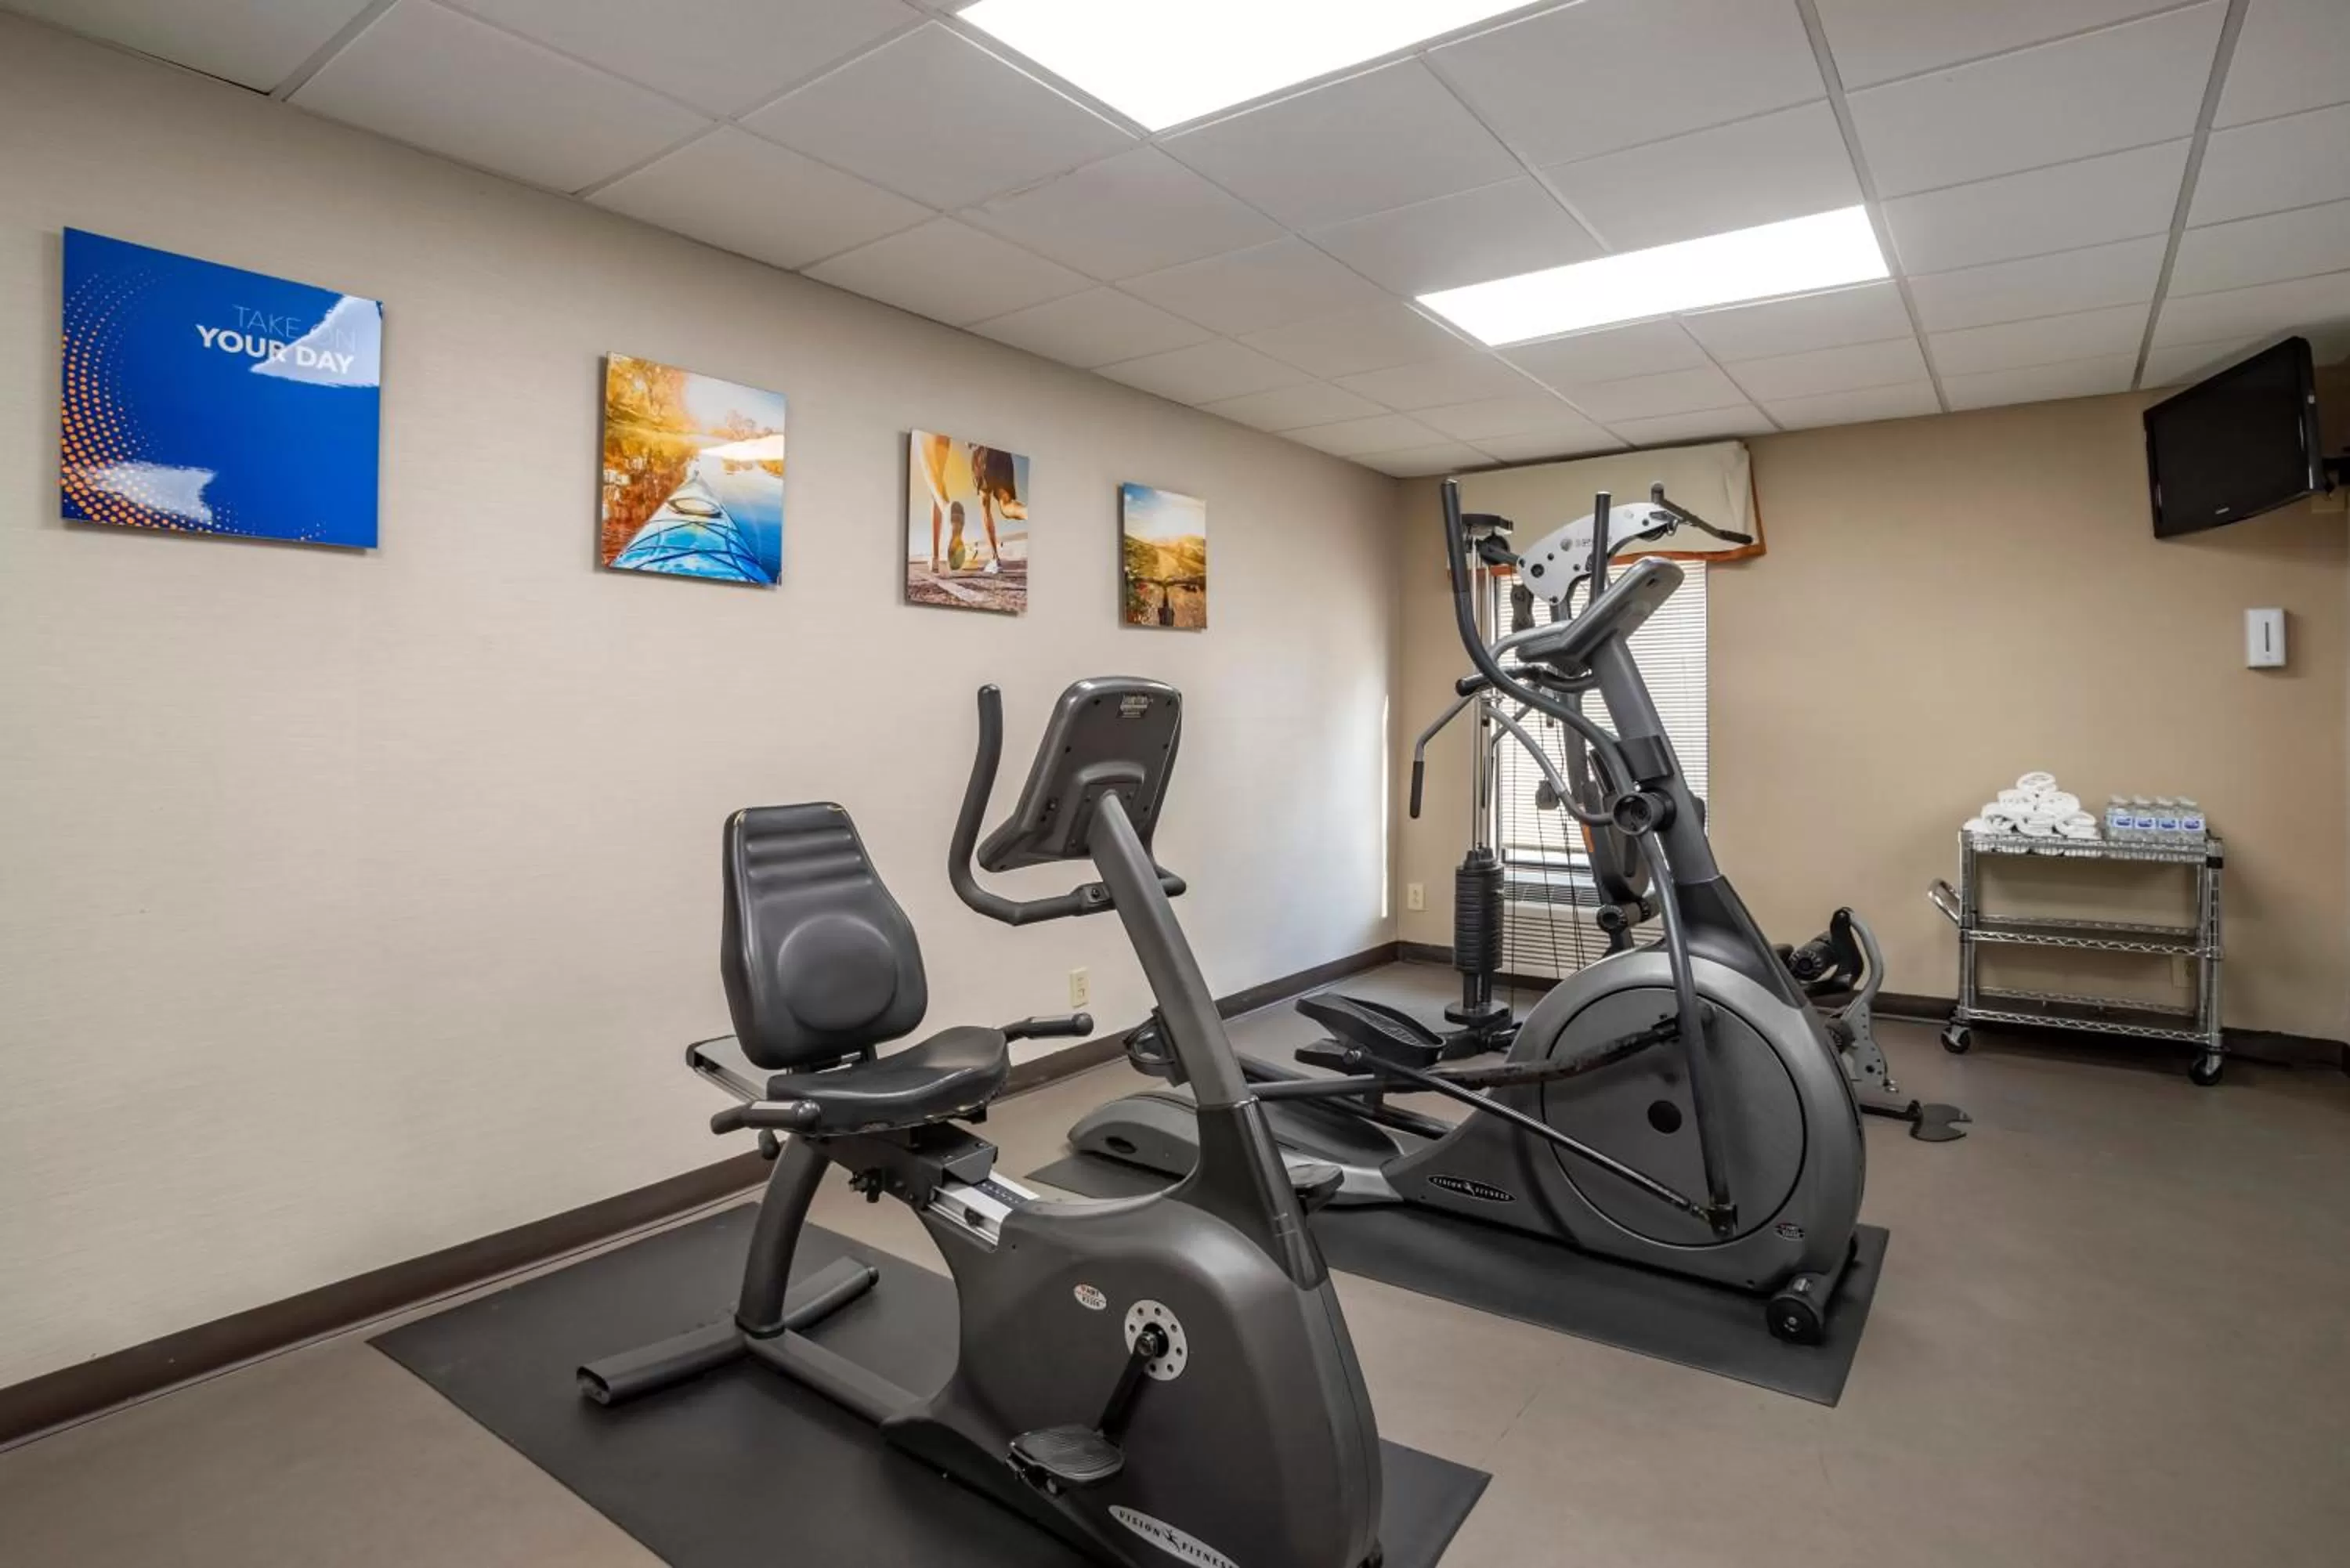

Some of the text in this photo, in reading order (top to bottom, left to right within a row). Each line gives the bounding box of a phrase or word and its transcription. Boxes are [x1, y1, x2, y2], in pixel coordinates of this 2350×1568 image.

[234, 305, 302, 339] TAKE
[196, 324, 354, 374] YOUR DAY
[1119, 1510, 1161, 1537] VISION
